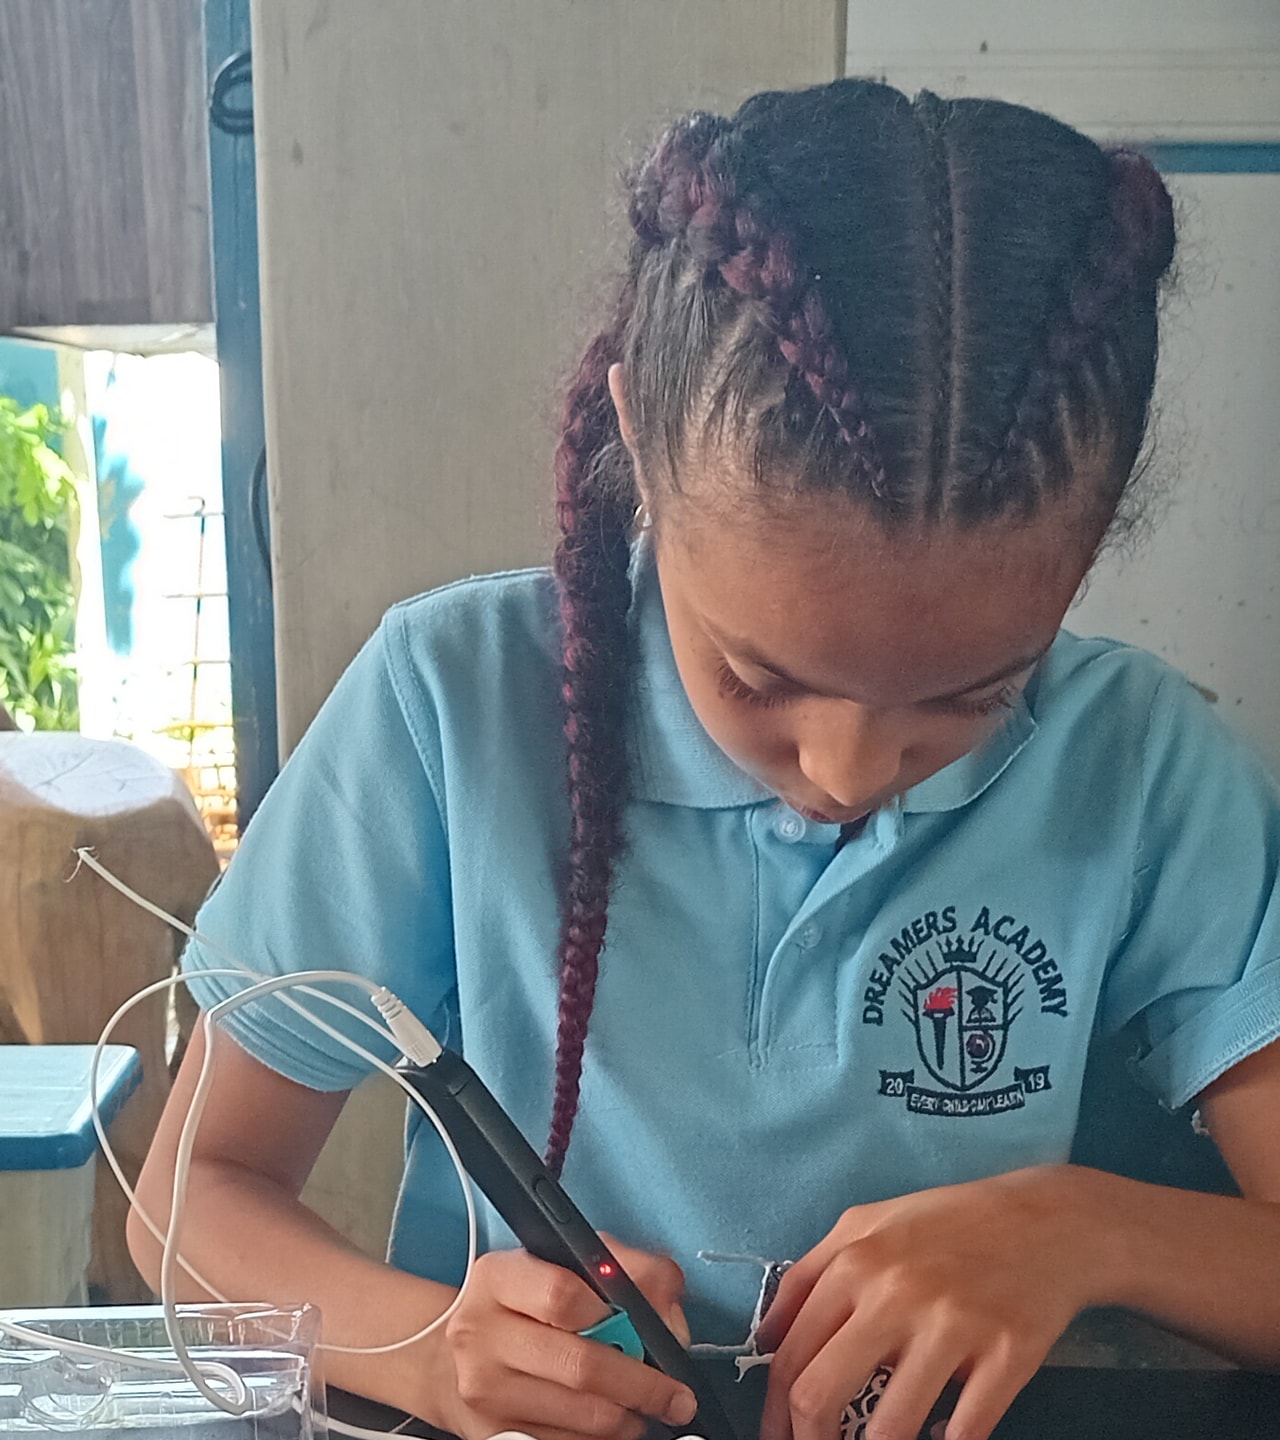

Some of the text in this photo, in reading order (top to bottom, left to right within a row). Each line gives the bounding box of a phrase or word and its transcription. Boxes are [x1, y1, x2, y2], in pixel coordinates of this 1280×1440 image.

[863, 906, 1068, 1026] DREAMERS ACADEMY
[886, 1078, 903, 1094] 20
[1029, 1073, 1045, 1089] 19
